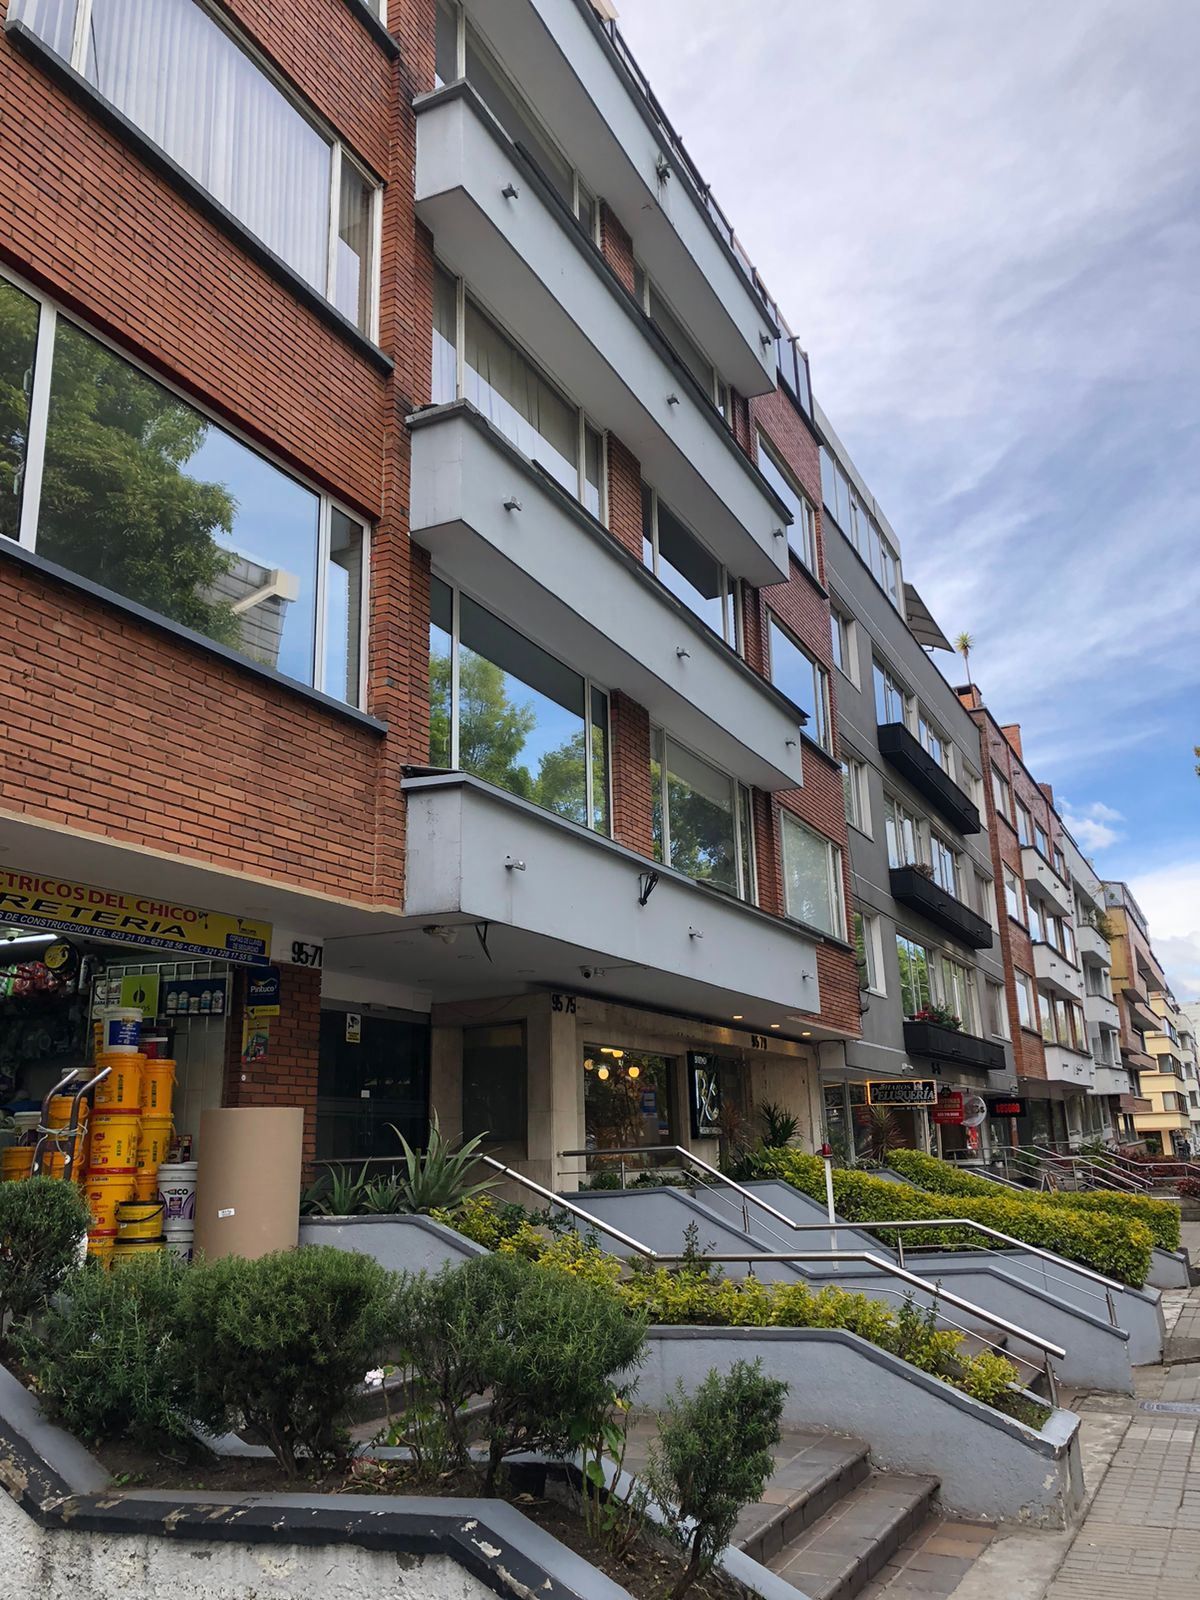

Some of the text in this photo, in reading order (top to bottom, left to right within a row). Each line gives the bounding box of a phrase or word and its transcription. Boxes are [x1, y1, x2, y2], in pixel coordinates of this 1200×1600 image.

[88, 889, 129, 909] DEL
[135, 900, 198, 922] CHICO
[5, 912, 20, 921] DE
[20, 915, 91, 934] CONSTRUCCION
[92, 928, 109, 937] TEL:
[110, 931, 126, 939] 623
[250, 985, 275, 993] Pintuco
[552, 994, 577, 1014] 95 75
[871, 1086, 935, 1104] PELUQUERÍA
